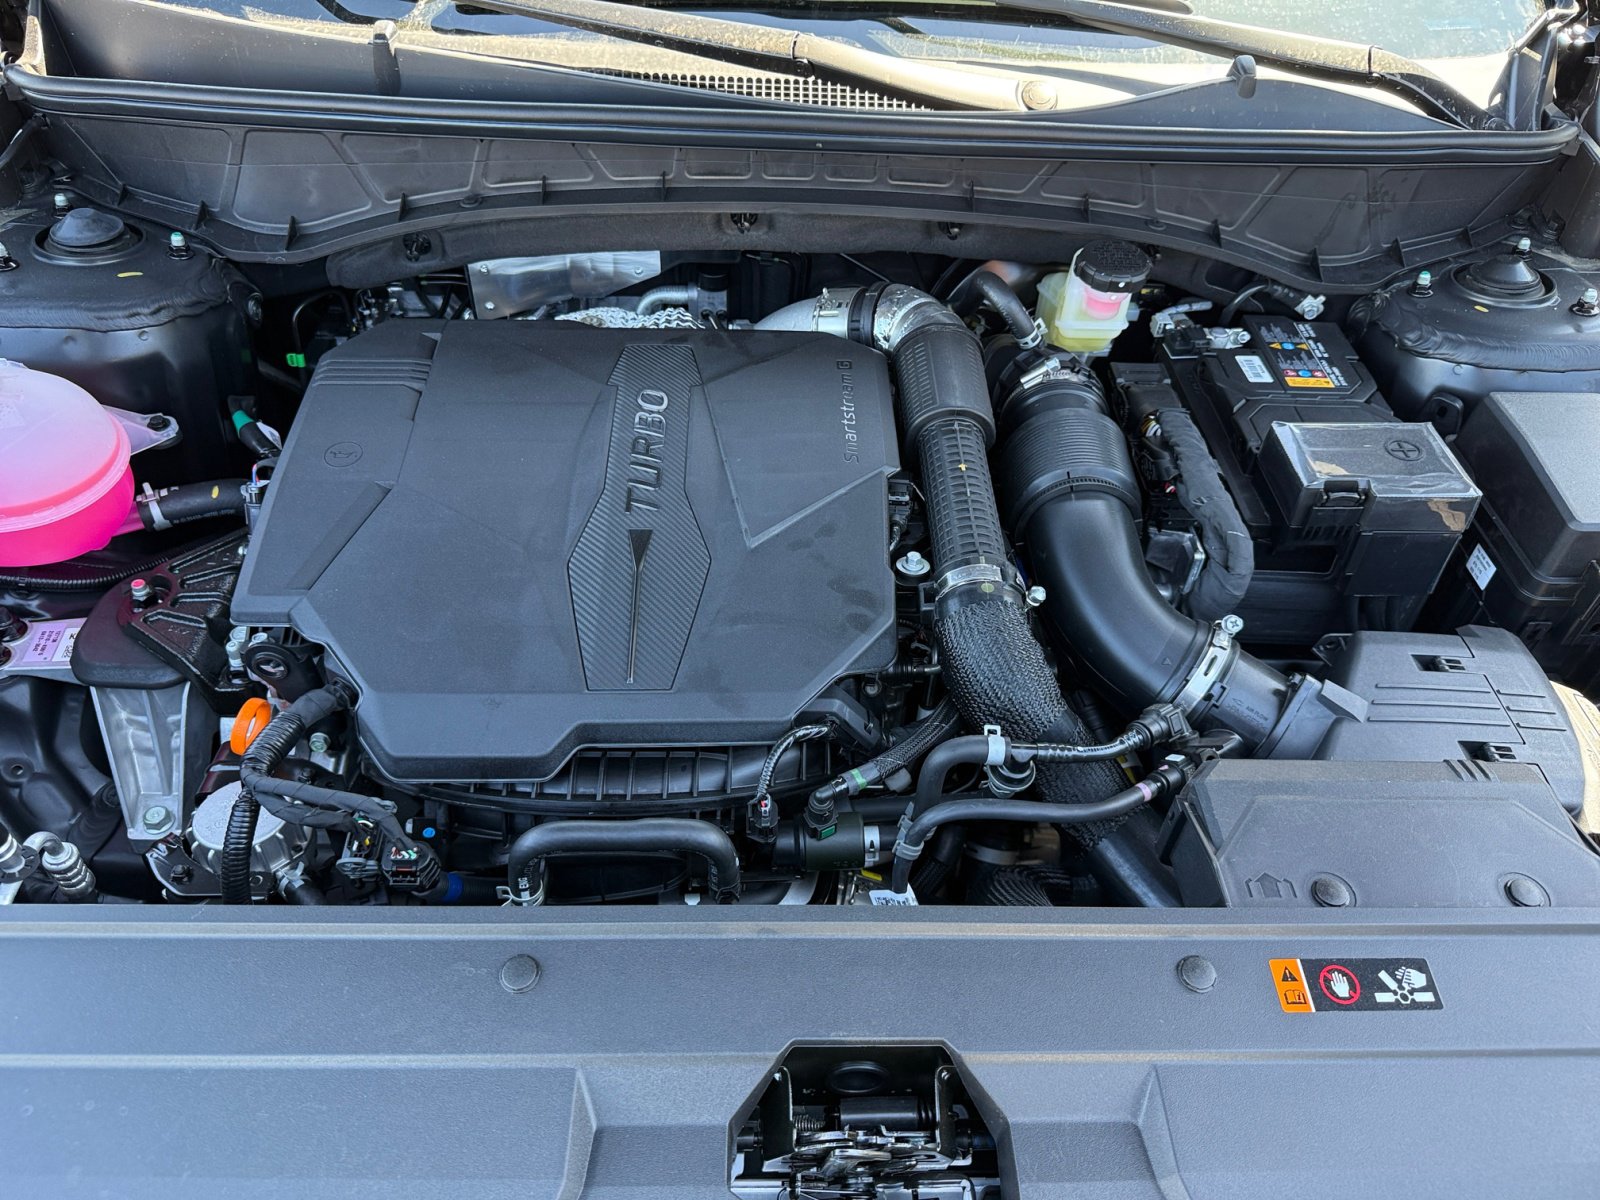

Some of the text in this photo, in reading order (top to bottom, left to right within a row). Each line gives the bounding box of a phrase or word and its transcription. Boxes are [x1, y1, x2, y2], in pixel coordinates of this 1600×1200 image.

[625, 389, 668, 514] TURBO
[836, 360, 859, 464] Smartstream G
